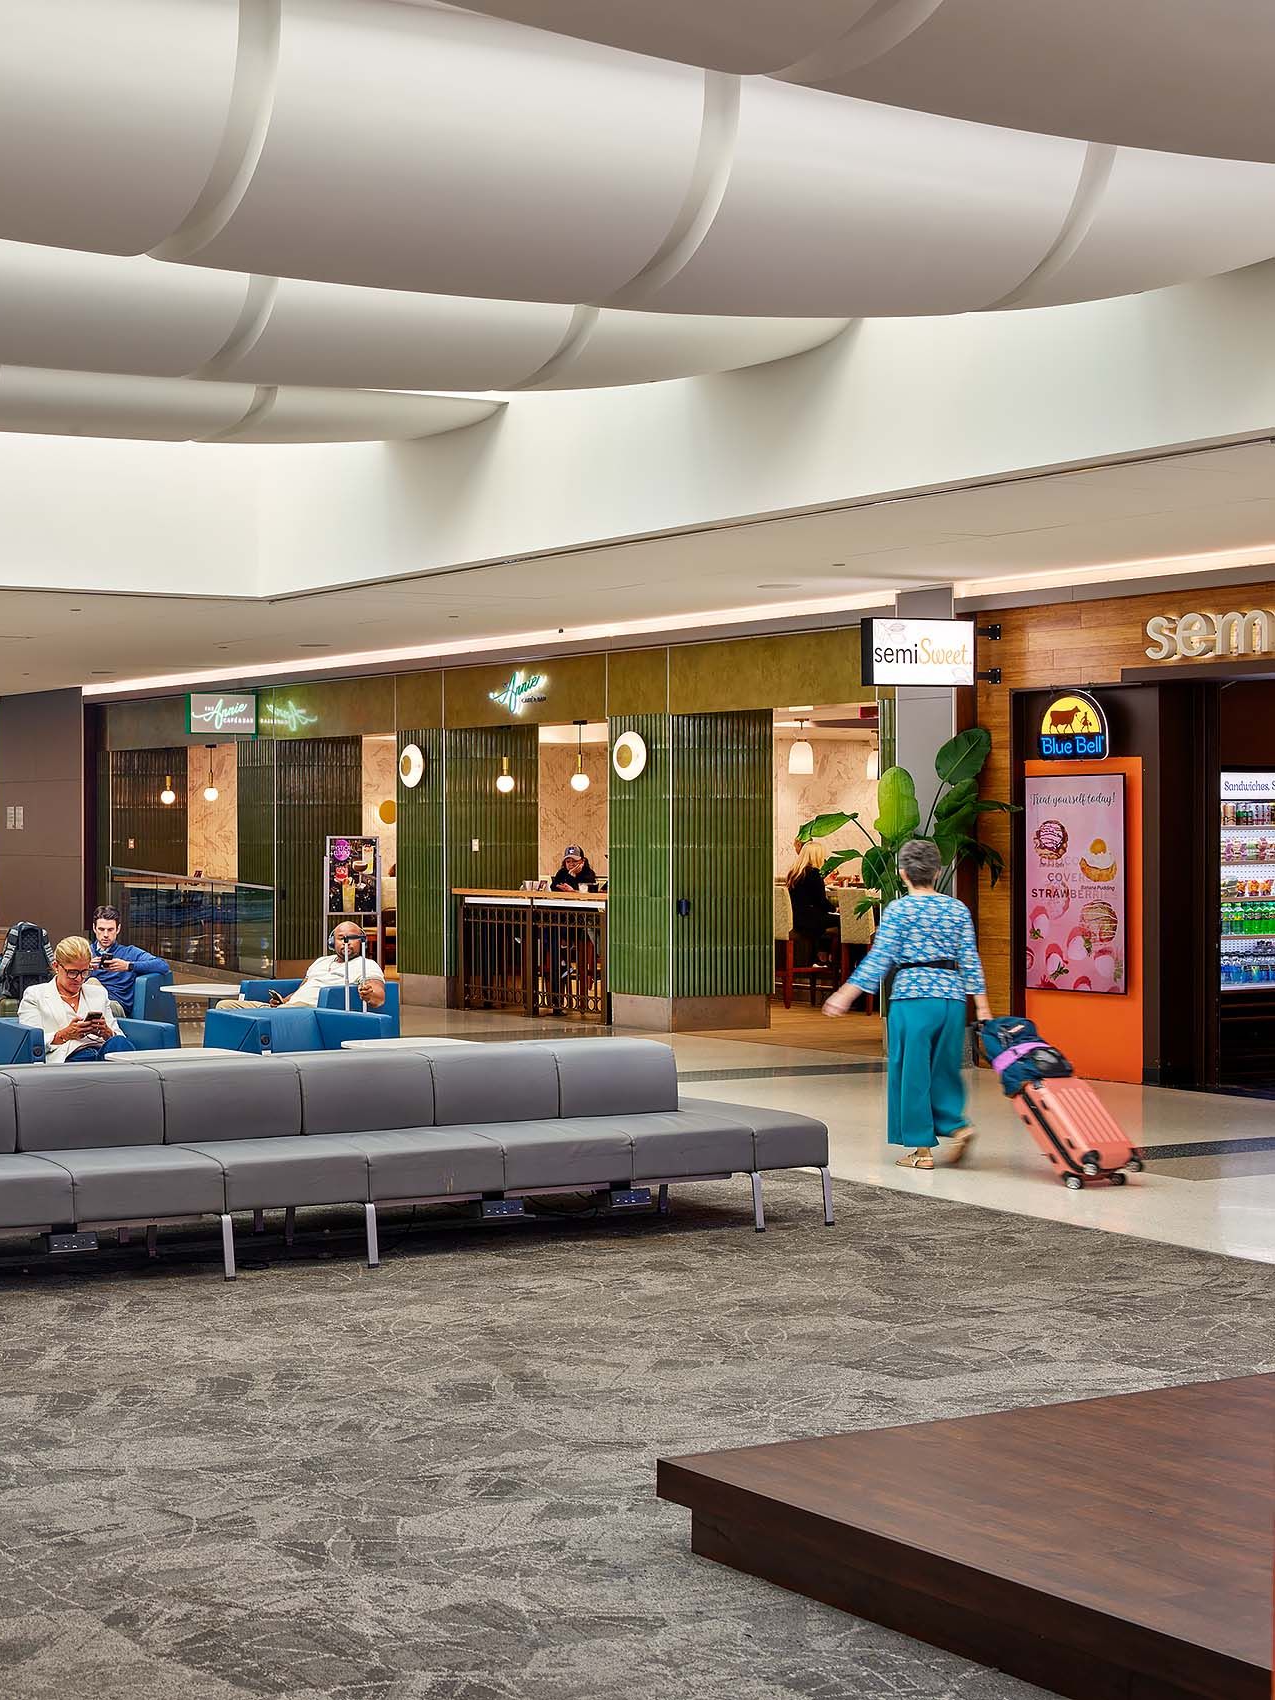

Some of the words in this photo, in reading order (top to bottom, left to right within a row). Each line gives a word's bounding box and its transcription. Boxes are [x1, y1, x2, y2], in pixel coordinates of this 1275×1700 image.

[191, 698, 248, 730] Annie
[1041, 736, 1073, 755] Blue
[1075, 735, 1102, 754] Bell
[1030, 792, 1051, 805] Treat
[1053, 792, 1087, 807] yourself
[1087, 791, 1116, 807] today!
